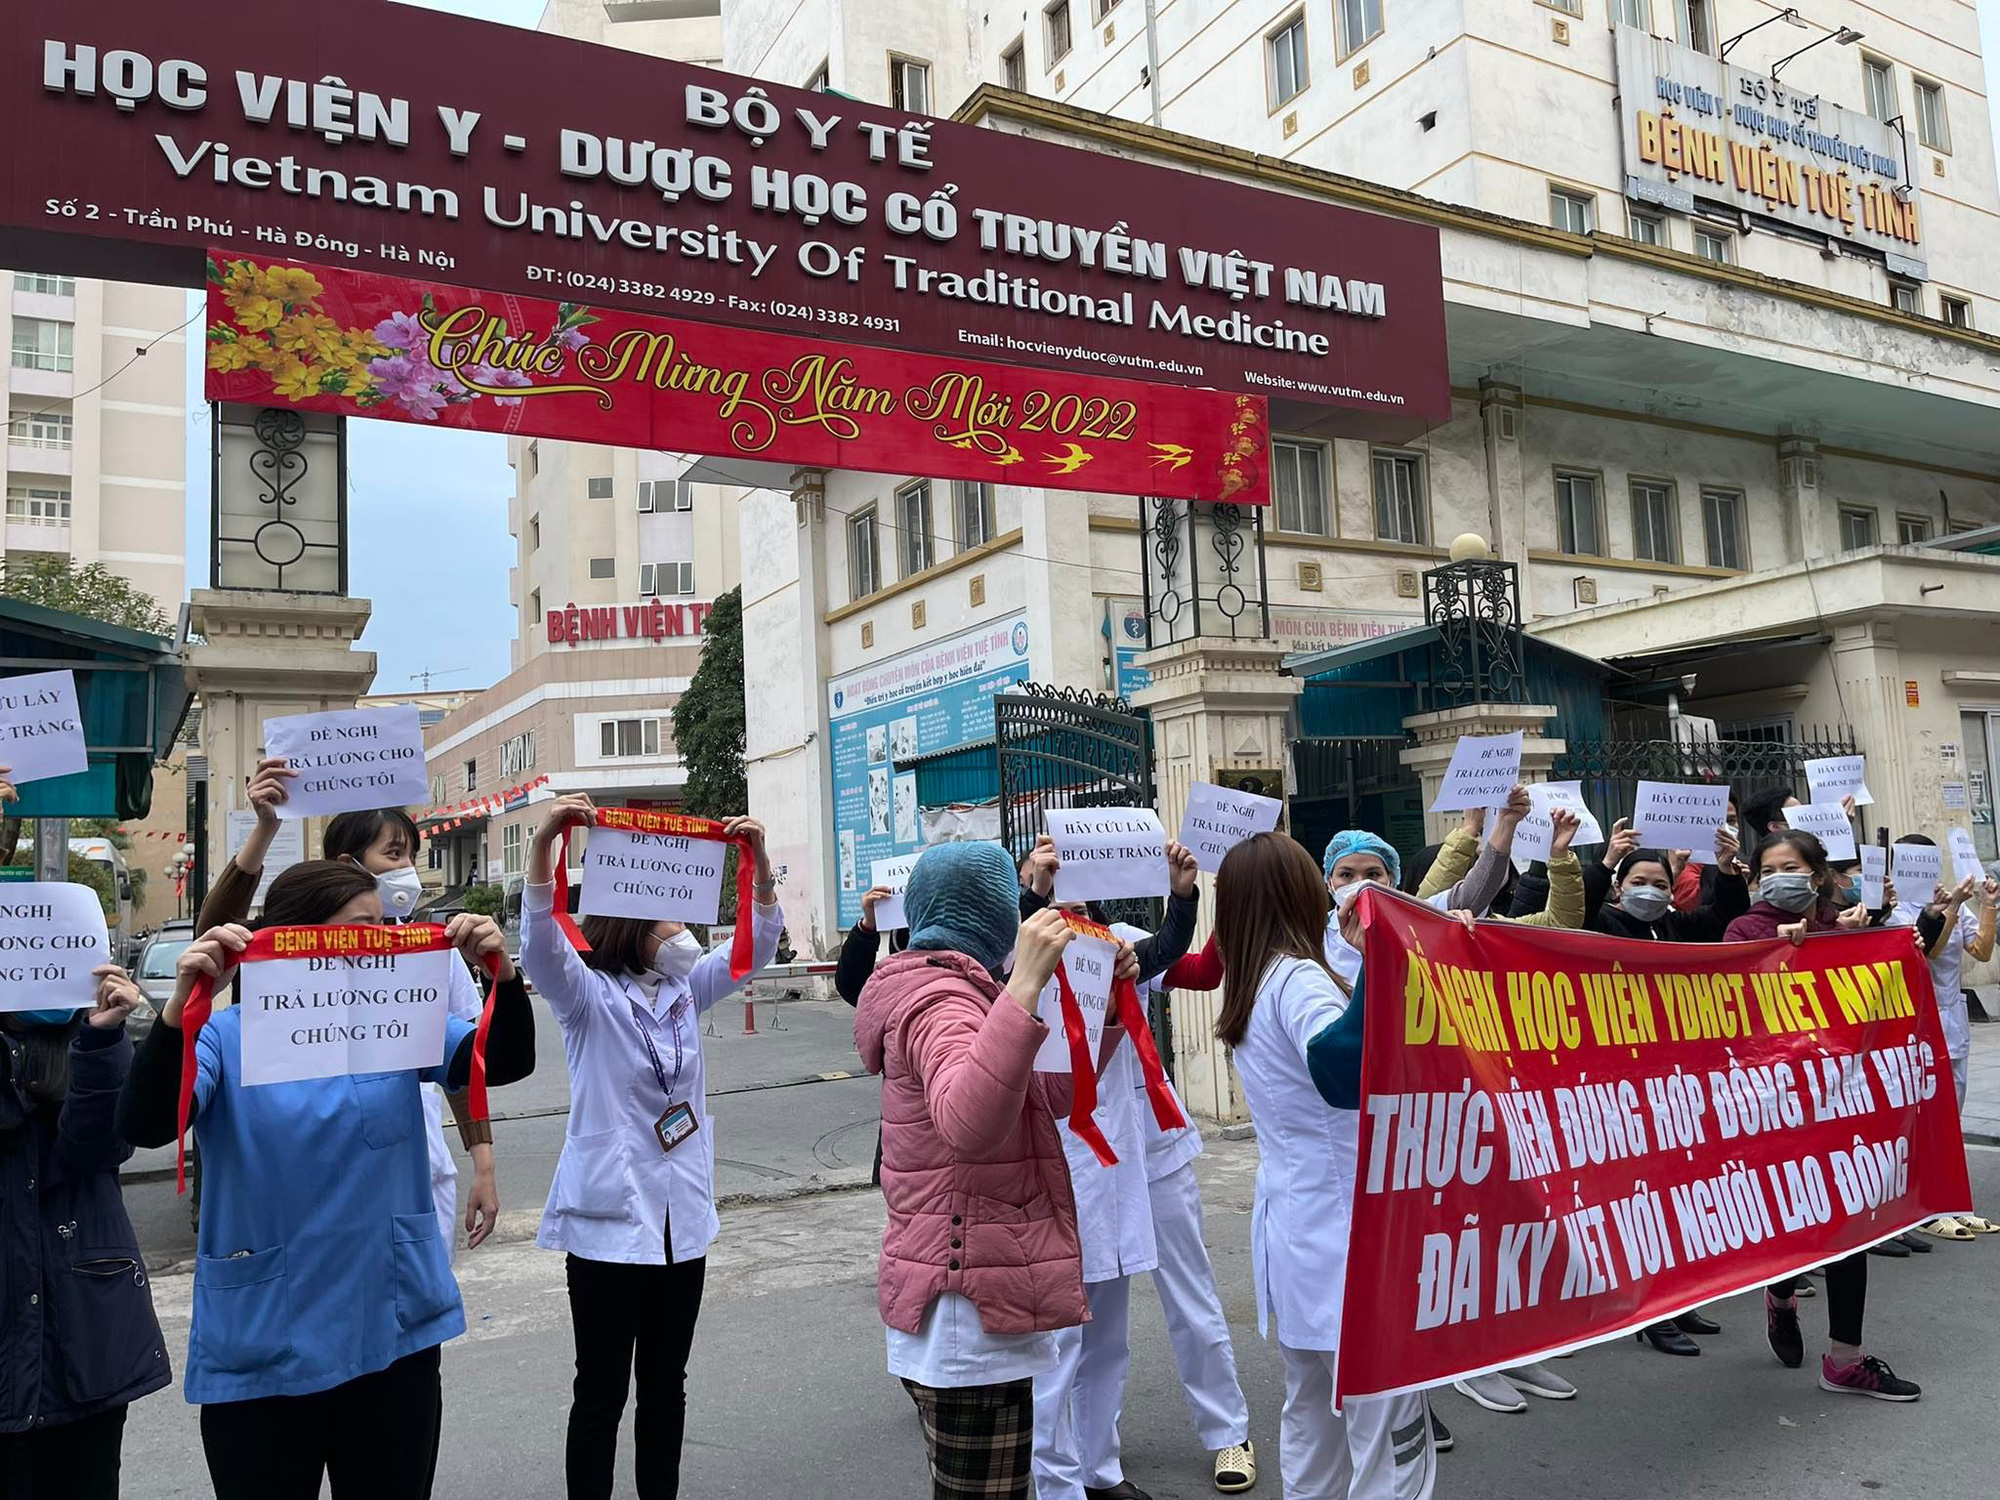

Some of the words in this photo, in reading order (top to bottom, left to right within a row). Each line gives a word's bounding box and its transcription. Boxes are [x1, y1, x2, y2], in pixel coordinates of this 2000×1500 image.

[684, 85, 782, 148] BỘ
[795, 107, 842, 149] Y
[857, 119, 935, 170] TẾ
[44, 39, 208, 112] HỌC
[235, 70, 410, 148] VIỆN
[437, 105, 482, 157] Y
[560, 128, 733, 203] DƯỢC
[751, 165, 868, 226] HỌC
[884, 182, 960, 242] CỔ
[972, 207, 1167, 281] TRUYỀN
[1178, 246, 1275, 304] VIỆT
[1284, 266, 1388, 318] NAM
[1637, 106, 1726, 184] BỆNH
[1729, 140, 1799, 212] VIỆN
[1801, 161, 1855, 234] TUỆ
[1858, 180, 1921, 244] TĨNH
[45, 197, 78, 218] Số
[85, 204, 100, 220] 2
[123, 207, 178, 231] Trần
[187, 215, 234, 238] Phú
[256, 226, 287, 246] Hà
[294, 230, 359, 259] Đông
[380, 244, 411, 263] Hà
[418, 249, 456, 270] Nội
[155, 134, 460, 220] Vietnam
[483, 185, 778, 278] University
[798, 240, 866, 282] Of
[883, 253, 1134, 327] Traditional
[1148, 299, 1331, 356] Medicine
[525, 265, 563, 286] ĐT:
[566, 270, 616, 294] (024)
[618, 279, 666, 300] 3382
[669, 285, 716, 306] 4929
[728, 295, 767, 315] Fax:
[770, 300, 814, 322] (024)
[816, 307, 860, 328] 3382
[862, 313, 900, 333] 4931
[958, 329, 1004, 348] Email:
[1006, 334, 1204, 377] hocvienyduoc@vutm.edu.vn
[577, 330, 778, 451] Mừng
[762, 354, 896, 440] Năm
[905, 373, 1014, 455] Mới
[1018, 391, 1137, 441] 2022
[547, 601, 618, 647] BỆNH
[623, 597, 685, 642] VIỆN
[336, 725, 378, 740] NGHỊ
[289, 754, 311, 770] RẢ
[317, 750, 375, 768] LƯƠNG
[379, 746, 415, 761] CHO
[304, 775, 362, 793] CHÚNG
[366, 771, 395, 787] TÔI
[1065, 820, 1092, 834] HÃY
[1644, 812, 1688, 824] BLOUSE
[653, 835, 690, 853] NGHỊ
[1062, 848, 1114, 861] BLOUSE
[596, 852, 626, 868] TRẢ
[630, 857, 682, 875] LƯƠNG
[685, 864, 715, 878] CHO
[613, 880, 665, 898] CHÚNG
[669, 886, 694, 900] TÔI
[0, 935, 44, 951] ƠNG
[51, 935, 97, 950] CHO
[274, 927, 317, 956] BỆNH
[323, 926, 359, 954] VIỆN
[364, 927, 393, 952] TUỆ
[30, 963, 67, 981] TÔI
[342, 955, 397, 973] NGHỊ
[259, 988, 305, 1011] TRẢ
[313, 987, 388, 1008] LƯƠNG
[394, 987, 438, 1005] CHO
[1506, 970, 1582, 1066] HỌC
[1580, 960, 1658, 1060] VIỆN
[1654, 972, 1752, 1042] YDHCT
[1749, 961, 1830, 1042] VIỆT
[1825, 960, 1916, 1025] NAM
[291, 1022, 366, 1046] CHÚNG
[373, 1019, 410, 1040] TÔI
[1366, 1078, 1495, 1206] THỰC
[1553, 1072, 1648, 1169] ĐÚNG
[1645, 1063, 1706, 1161] HỢP
[1709, 1047, 1804, 1140] ĐỒNG
[1802, 1048, 1876, 1122] LÀM
[1870, 1034, 1937, 1114] VIỆC
[1415, 1213, 1481, 1332] ĐÃ
[1494, 1205, 1557, 1316] KÝ
[1609, 1178, 1676, 1281] VỚI
[1670, 1159, 1774, 1263] NGƯỜI
[1767, 1155, 1832, 1234] LAO
[1829, 1134, 1909, 1221] ĐỘNG
